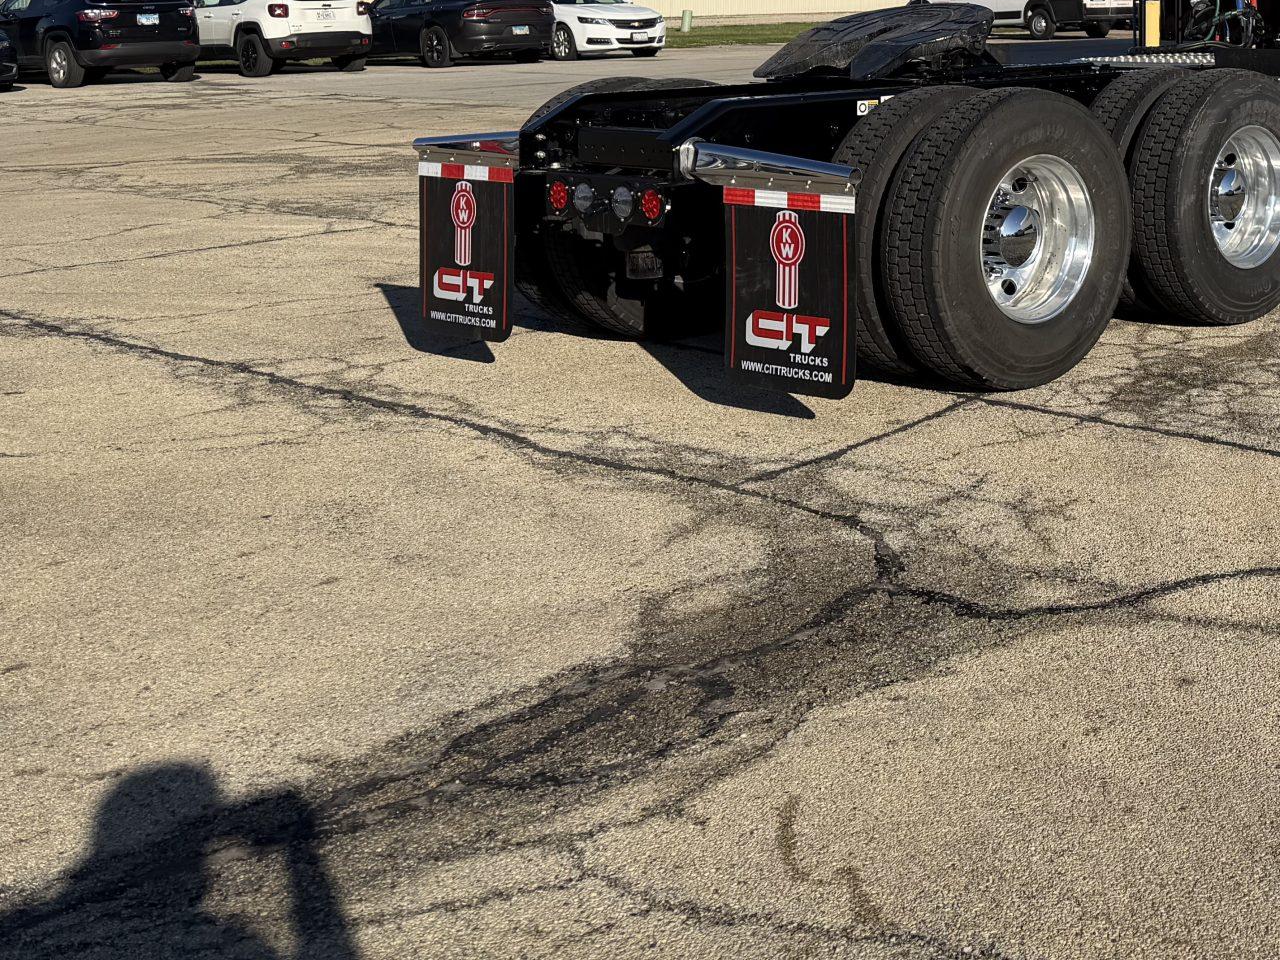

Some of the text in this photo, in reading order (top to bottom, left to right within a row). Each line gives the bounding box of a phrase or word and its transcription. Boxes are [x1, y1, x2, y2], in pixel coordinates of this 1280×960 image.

[433, 267, 495, 304] CIT
[430, 310, 496, 329] WWW.CITTRUCKS.COM
[465, 303, 493, 315] TRUCKS
[746, 309, 830, 353] CIT
[790, 353, 829, 367] TRUCKS
[741, 359, 833, 383] WWW.CITTRUCKS.COM
